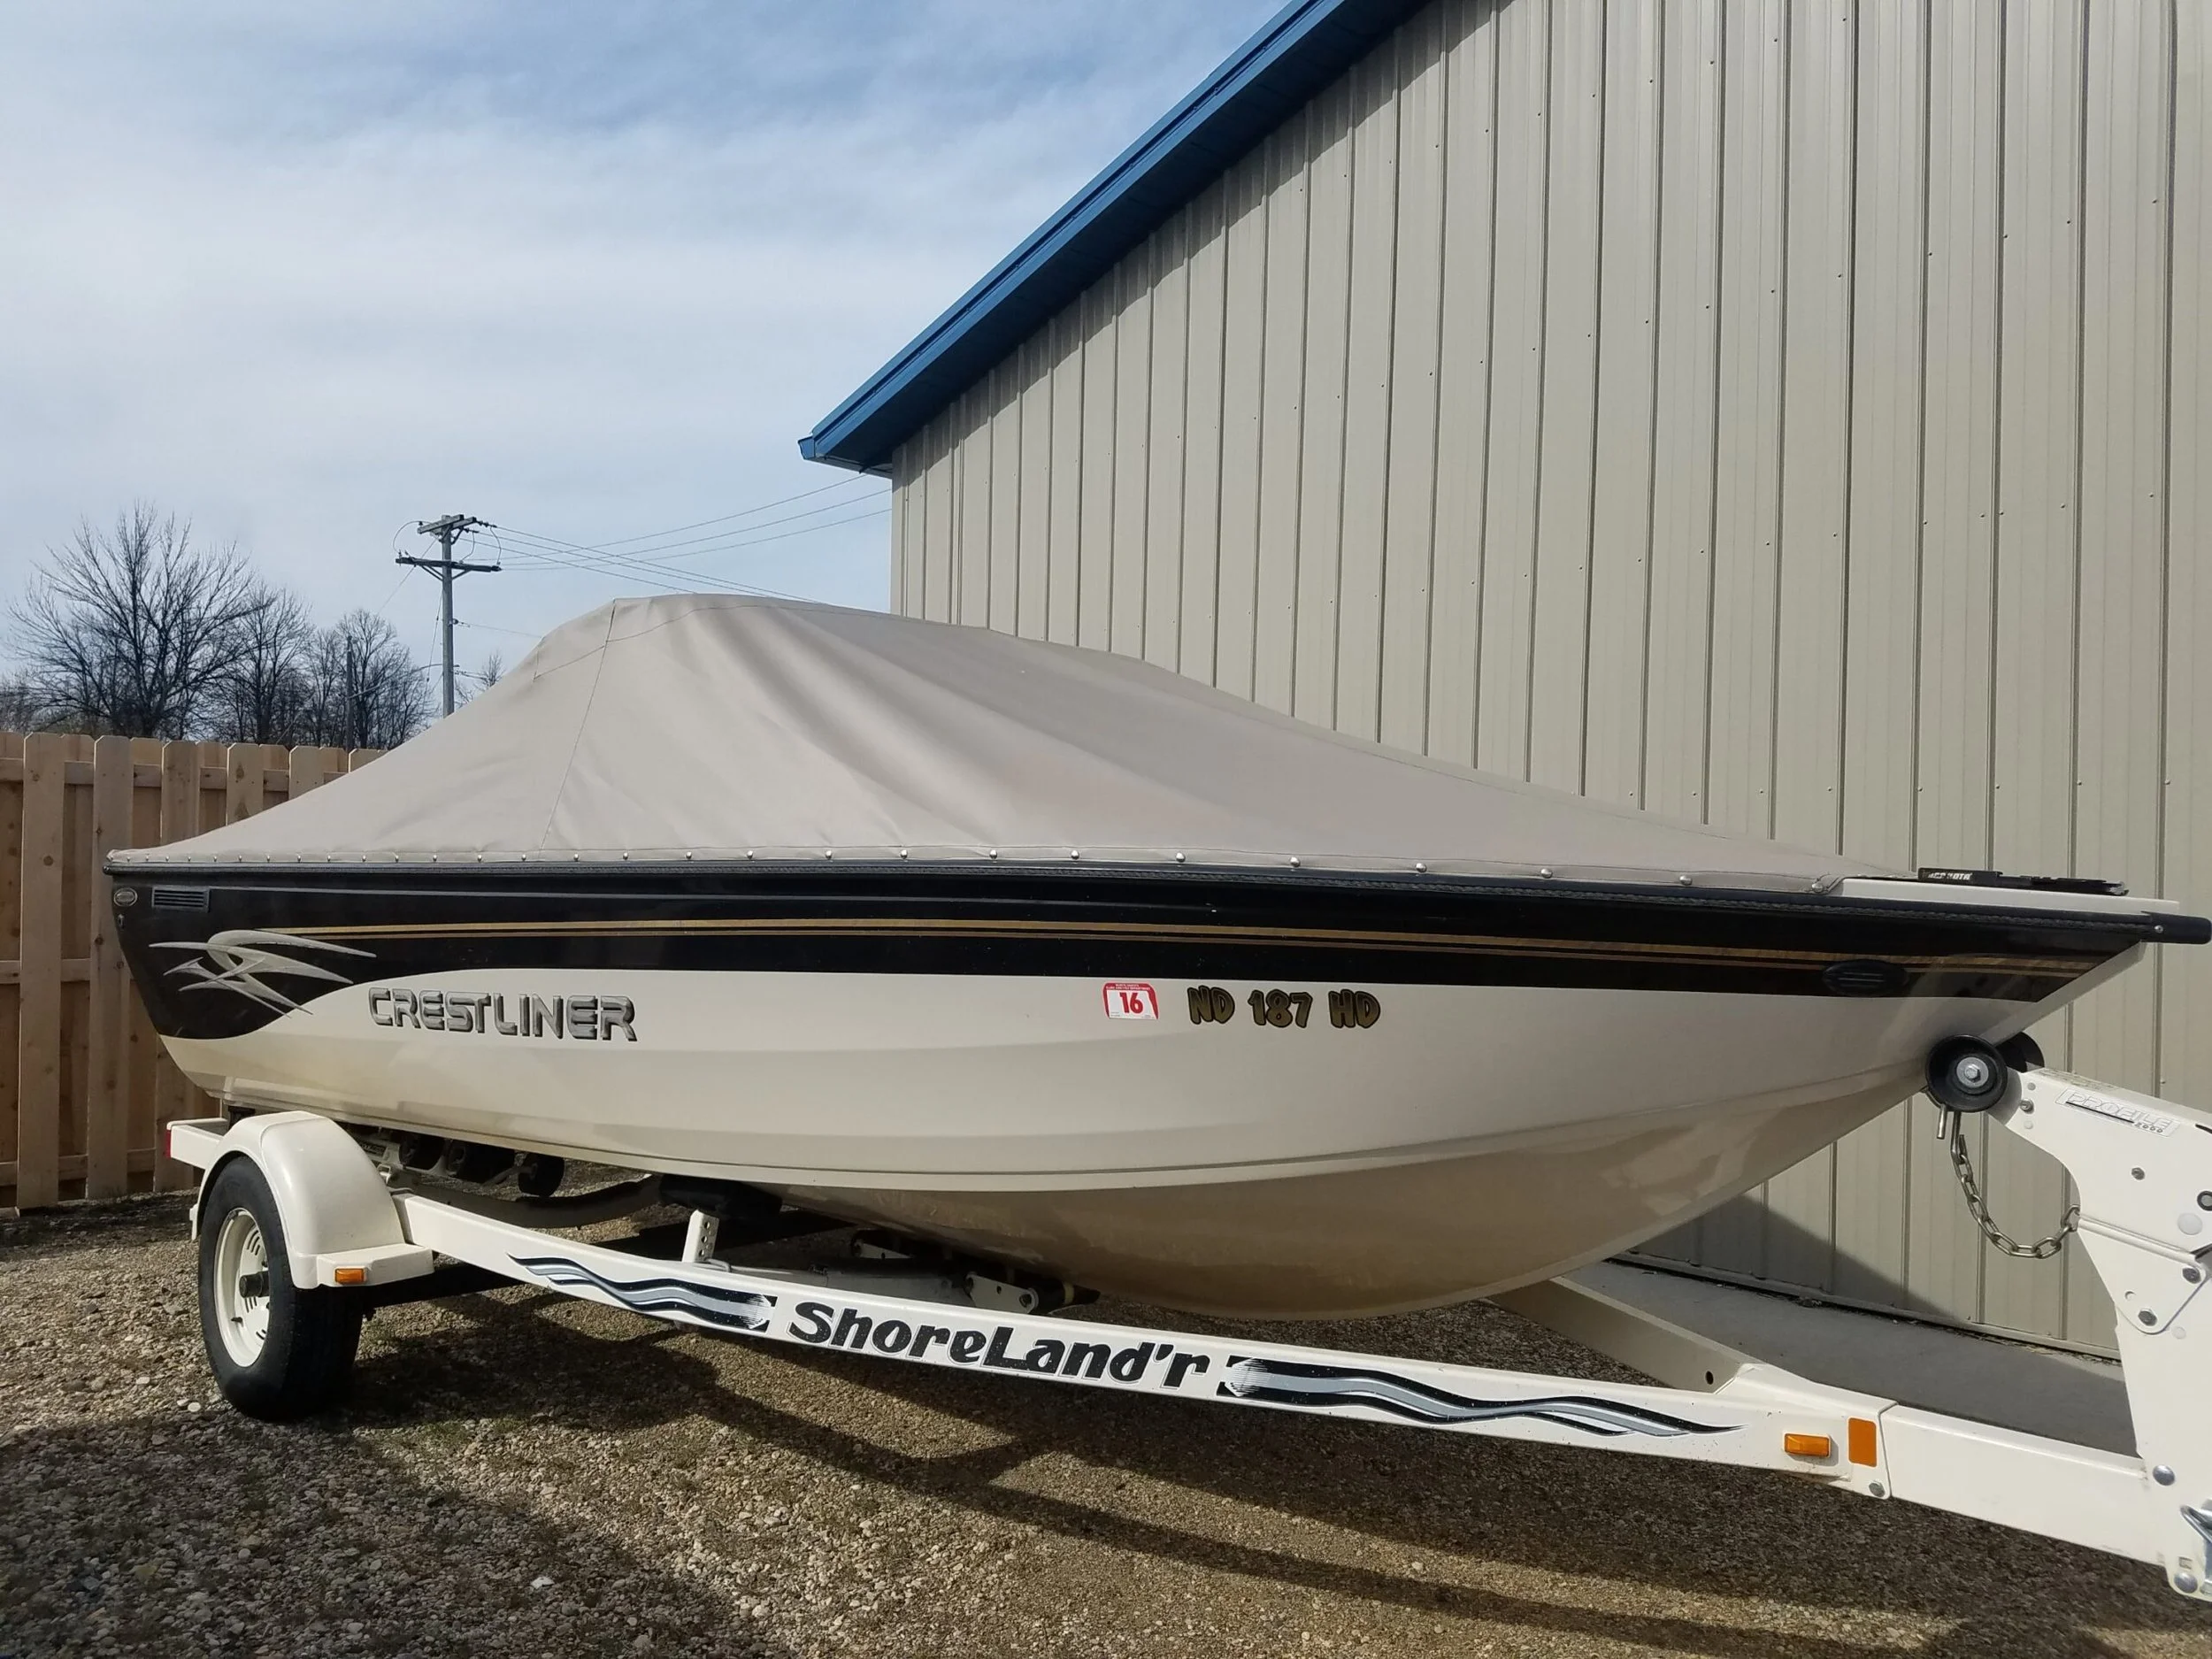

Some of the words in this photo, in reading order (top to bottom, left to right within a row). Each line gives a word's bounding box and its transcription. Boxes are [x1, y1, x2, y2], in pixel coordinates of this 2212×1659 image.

[368, 987, 637, 1041] CRESTLINER
[1119, 992, 1143, 1014] 16
[1187, 985, 1235, 1025] ND
[1248, 989, 1313, 1028] 187
[1328, 989, 1380, 1029] HD
[2069, 1091, 2171, 1129] PROFILE
[790, 1302, 1210, 1387] ShoreLand'r
